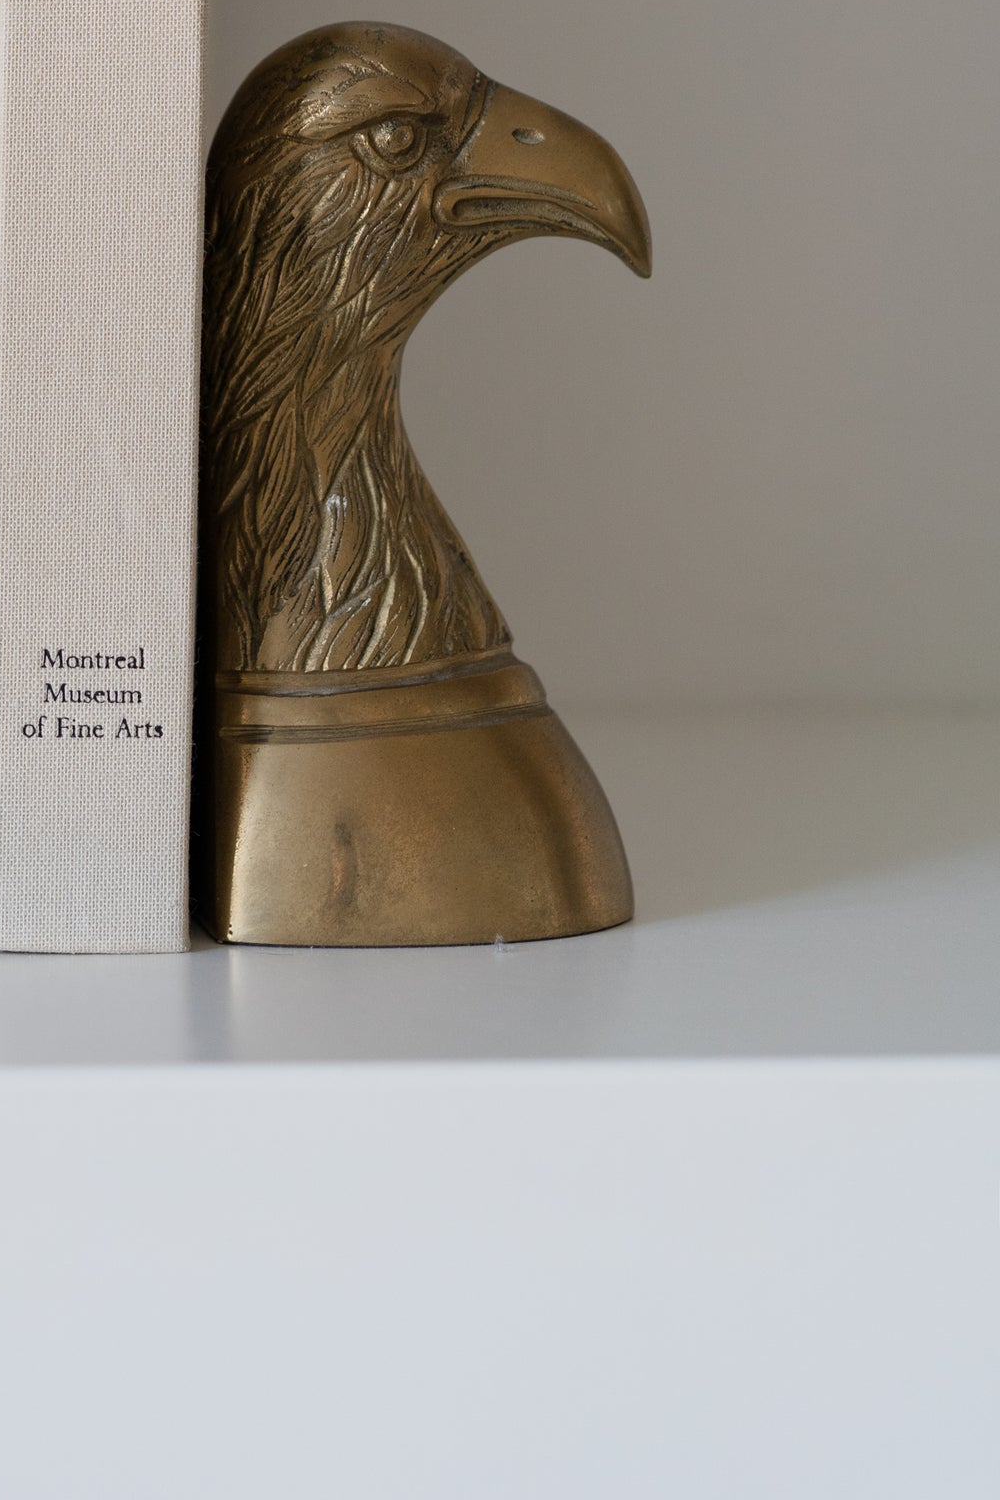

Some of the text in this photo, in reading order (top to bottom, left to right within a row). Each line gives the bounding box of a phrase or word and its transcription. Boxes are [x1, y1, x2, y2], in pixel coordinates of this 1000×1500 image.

[41, 648, 145, 669] Montreal
[43, 683, 142, 703] Museum
[22, 716, 164, 738] of Fine Arts
